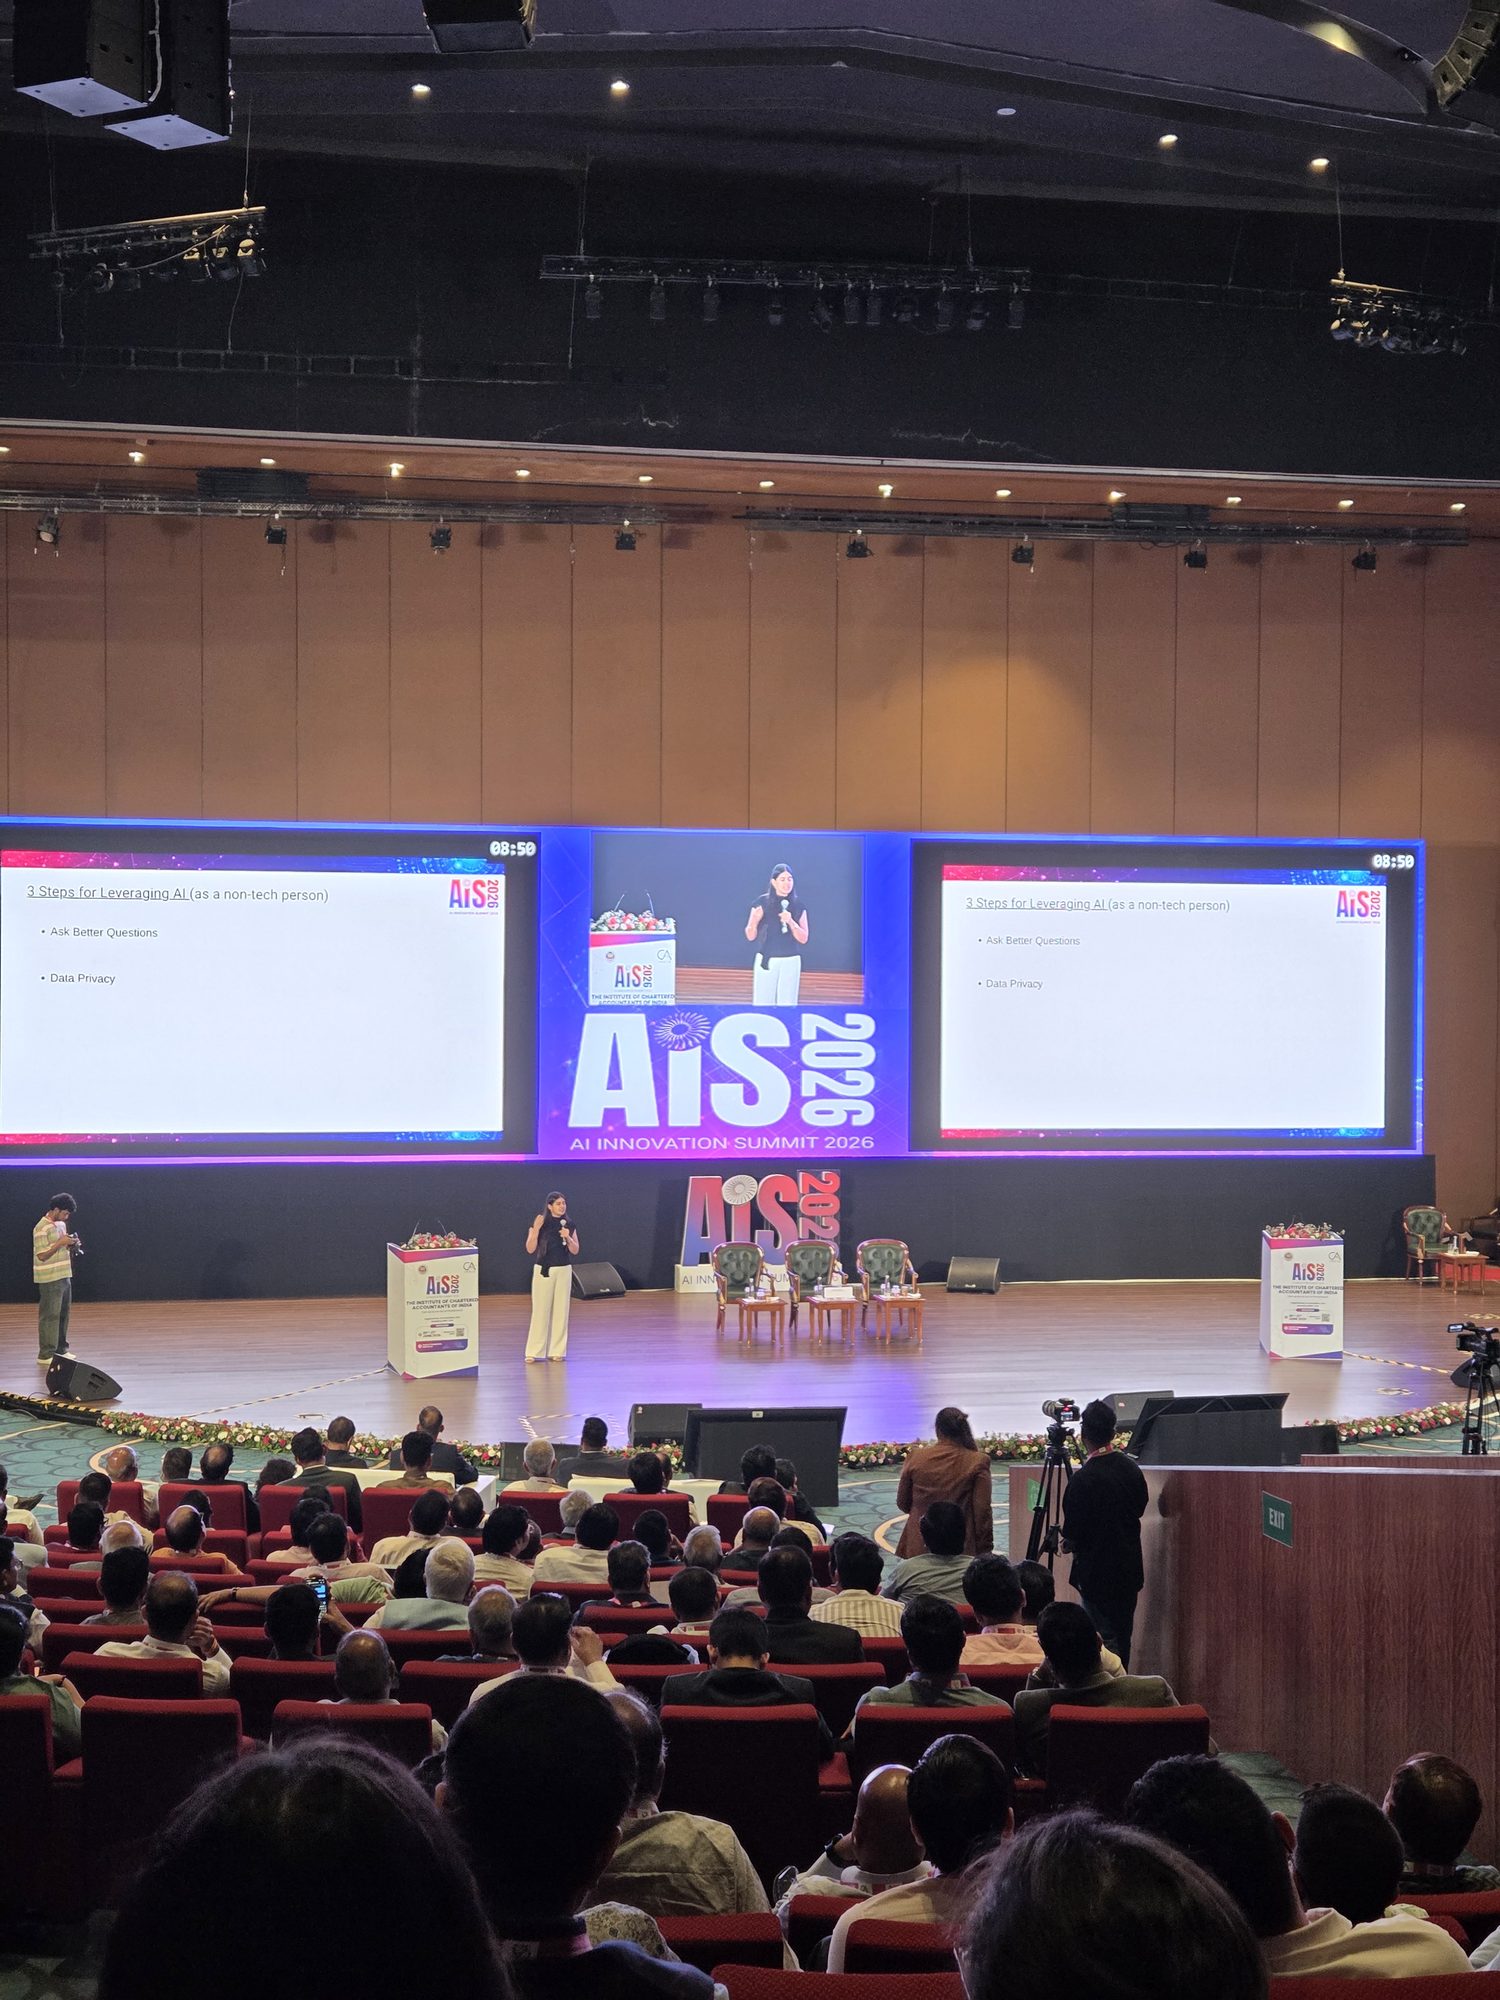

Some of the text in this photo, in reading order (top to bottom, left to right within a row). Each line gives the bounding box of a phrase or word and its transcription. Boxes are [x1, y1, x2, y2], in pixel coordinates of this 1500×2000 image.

[489, 841, 537, 857] 08:50
[1372, 854, 1415, 869] 08:50
[27, 885, 329, 903] 3 Steps for Leveraging AI (as a non-tech person)
[487, 880, 499, 909] 2026
[966, 897, 1230, 913] 3 Steps for Leveraging AI (as a non-tech person)
[1370, 890, 1381, 918] 2026
[50, 926, 158, 939] Ask Better Questions
[986, 936, 1081, 946] Ask Better Questions
[50, 973, 116, 985] Data Privacy
[642, 964, 653, 988] 2026
[986, 979, 1044, 990] Data Privacy
[568, 1012, 792, 1128] AiS
[801, 1013, 876, 1127] 2026
[570, 1136, 875, 1150] AI INNOVATION SUMMIT 2026
[1316, 1263, 1325, 1281] 2026
[451, 1275, 460, 1294] 2026
[1268, 1507, 1285, 1530] EXIT
